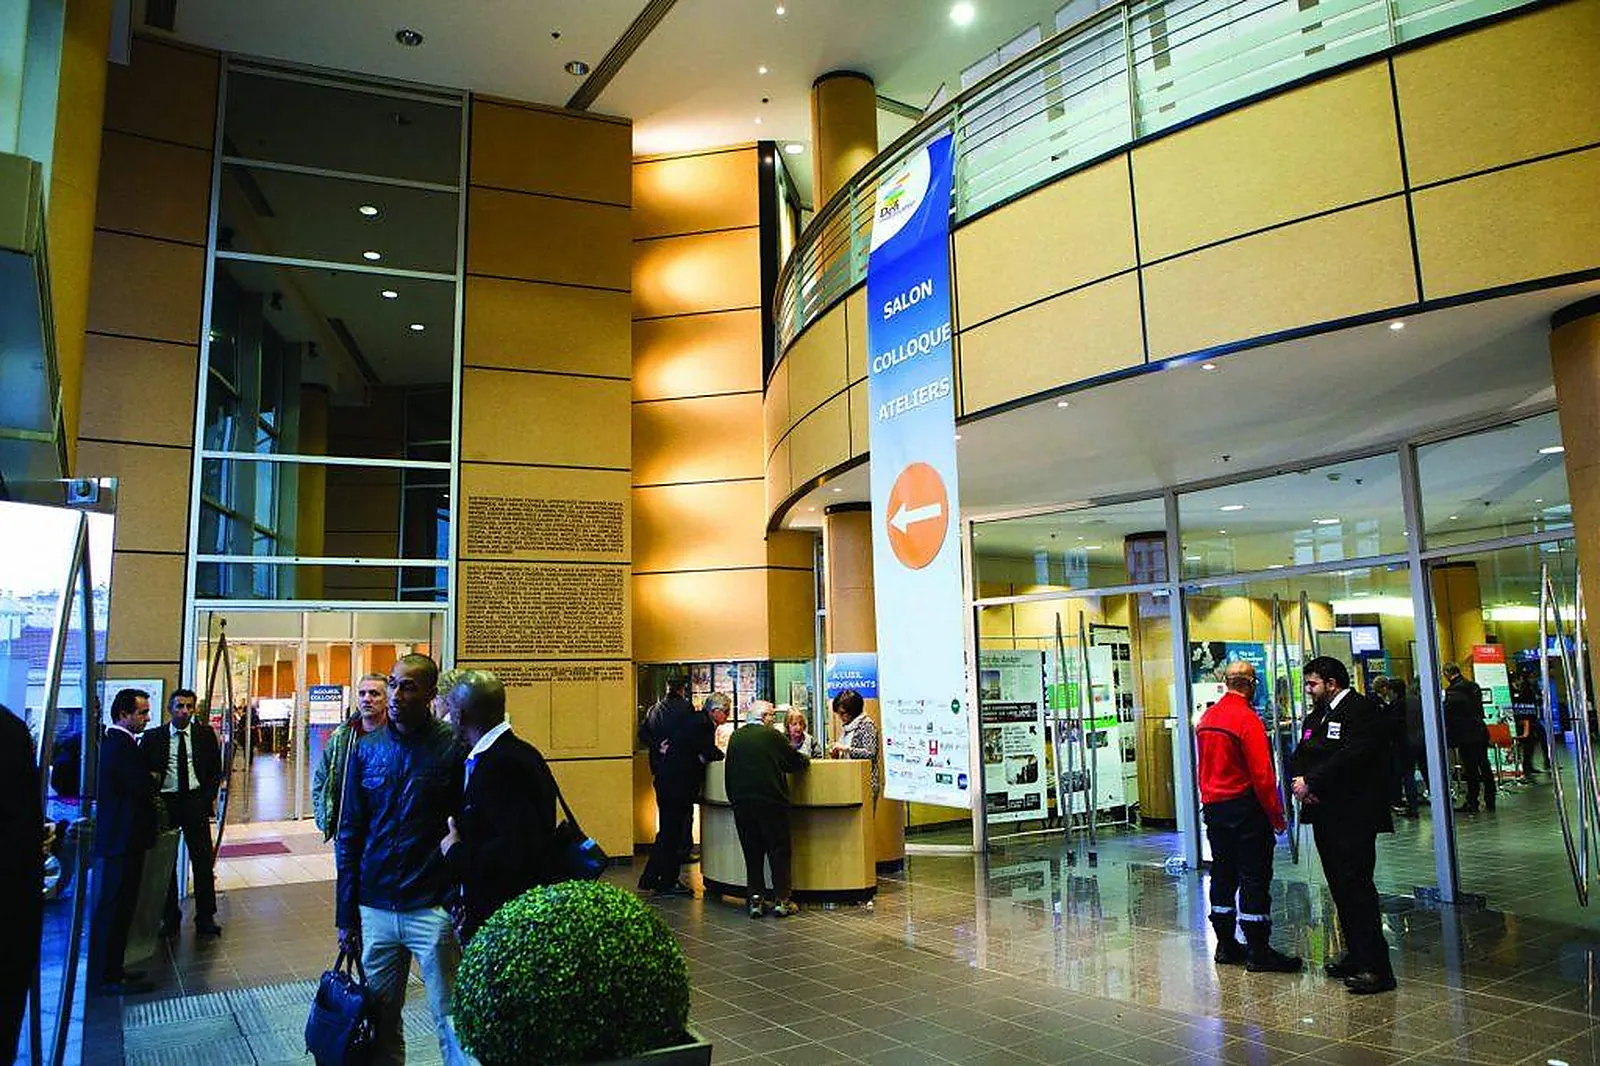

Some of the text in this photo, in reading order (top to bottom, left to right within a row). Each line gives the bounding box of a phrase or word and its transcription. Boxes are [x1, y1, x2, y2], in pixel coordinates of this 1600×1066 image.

[883, 279, 933, 320] SALON
[872, 325, 952, 374] COLLOQUE
[878, 378, 951, 421] ATELIERS
